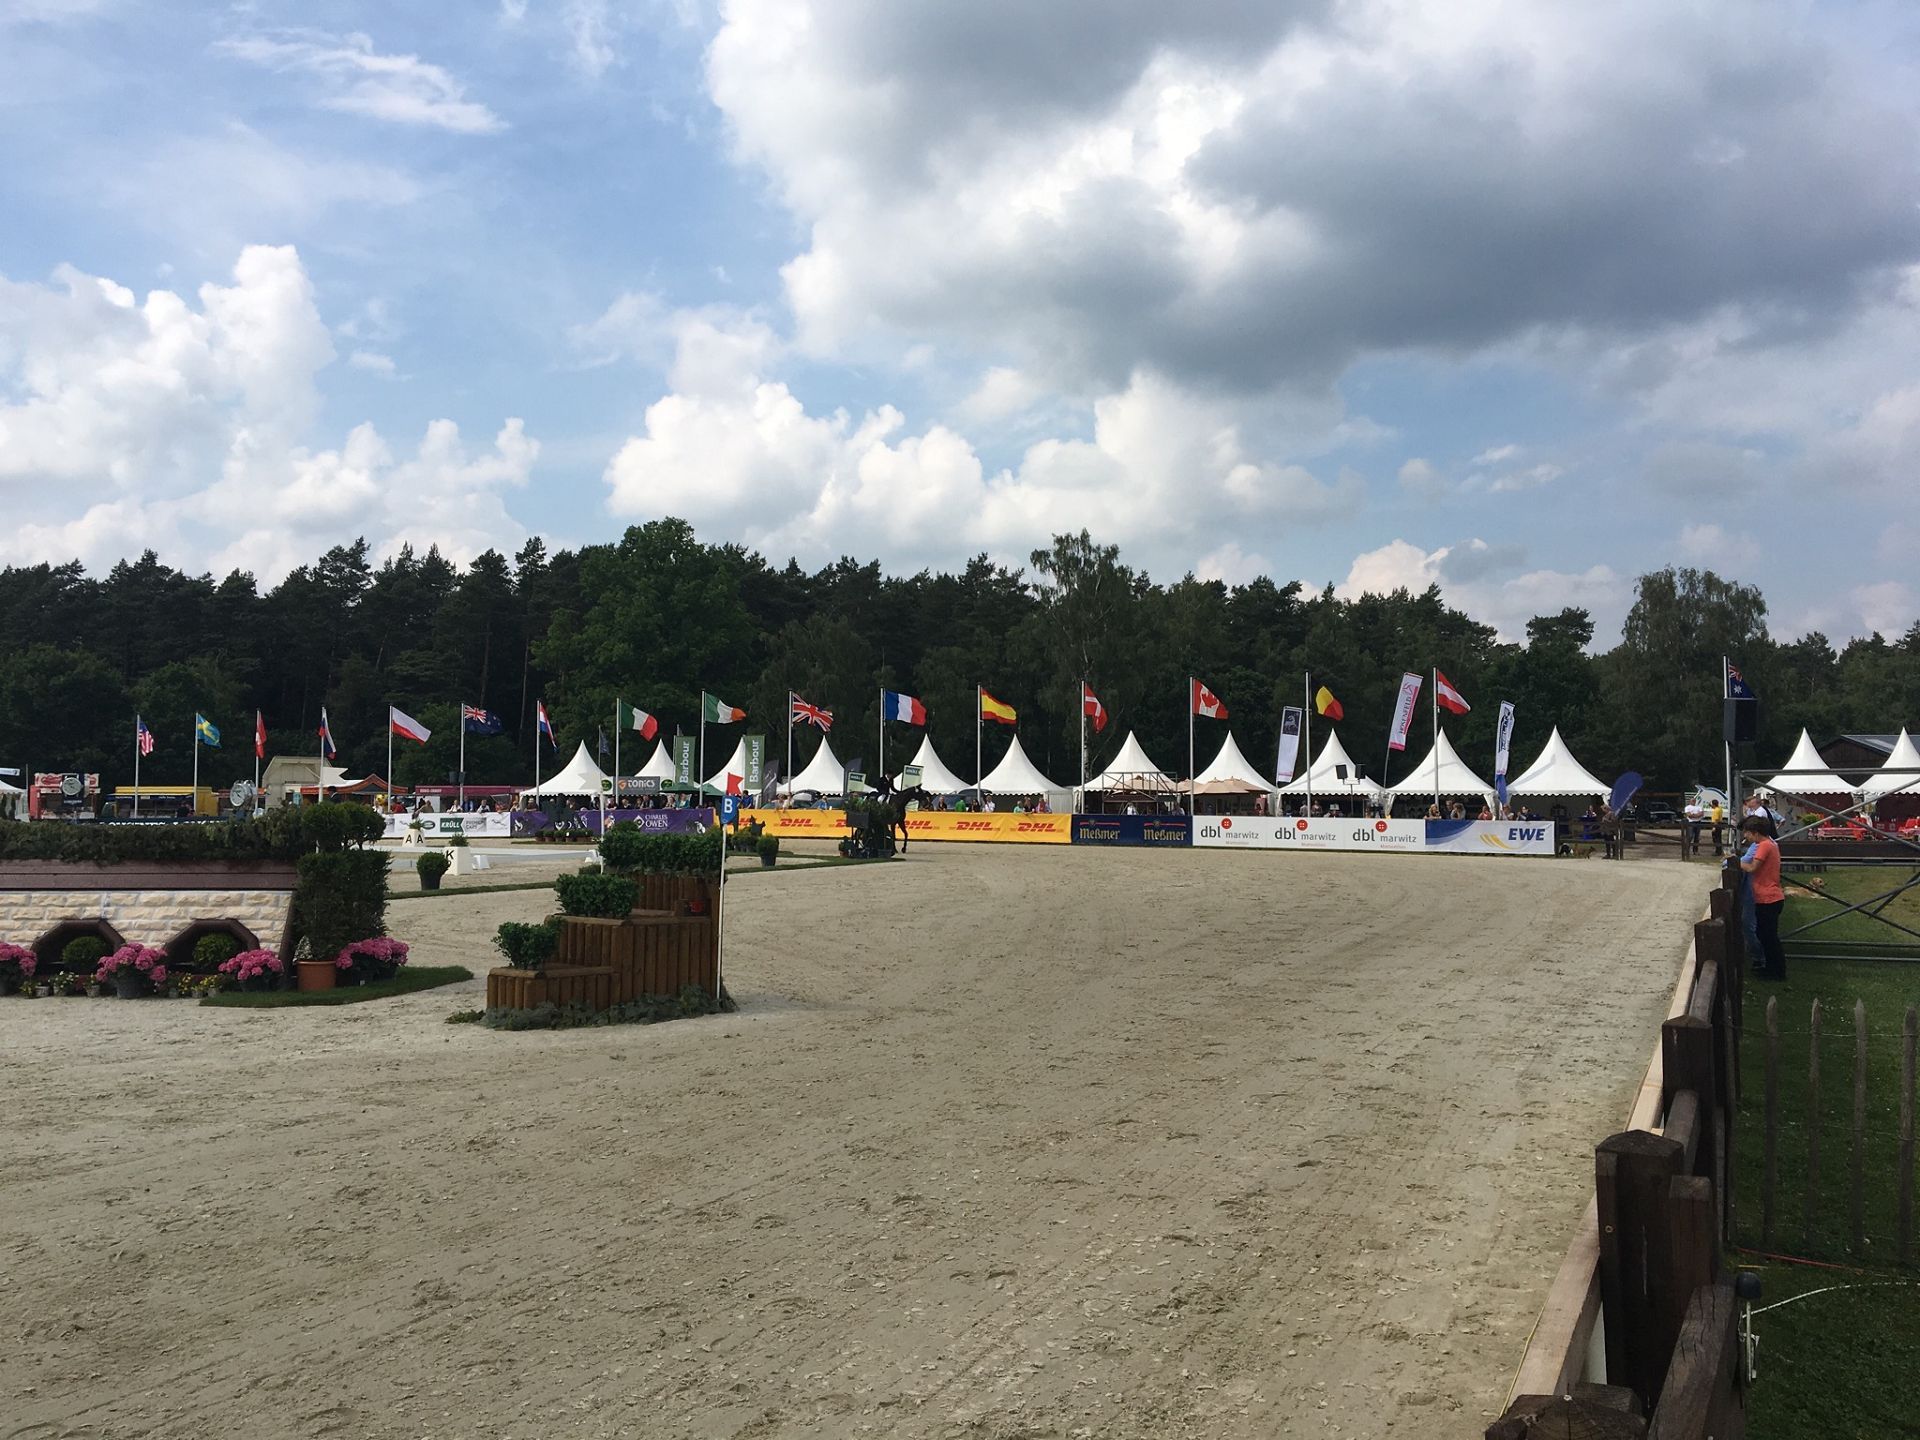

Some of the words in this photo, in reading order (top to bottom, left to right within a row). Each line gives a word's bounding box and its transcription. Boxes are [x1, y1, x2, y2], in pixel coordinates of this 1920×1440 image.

[679, 741, 690, 783] Barbour
[749, 740, 760, 783] Barbour
[724, 798, 733, 813] B
[441, 820, 460, 828] KRÜLL
[645, 820, 668, 828] OWEN
[779, 818, 814, 827] DHL
[956, 821, 994, 831] DHL
[1017, 822, 1056, 832] DHL
[405, 834, 412, 843] A
[416, 834, 424, 843] A
[1079, 828, 1120, 840] Meßmer
[1144, 829, 1186, 841] Meßmer
[1200, 826, 1221, 838] dbl
[1225, 831, 1259, 839] marwitz
[1274, 827, 1296, 840] dbl
[1300, 832, 1336, 841] marwitz
[1352, 829, 1375, 842] dbl
[1380, 833, 1417, 843] marwitz
[1508, 828, 1545, 840] EWE
[445, 850, 454, 859] K
